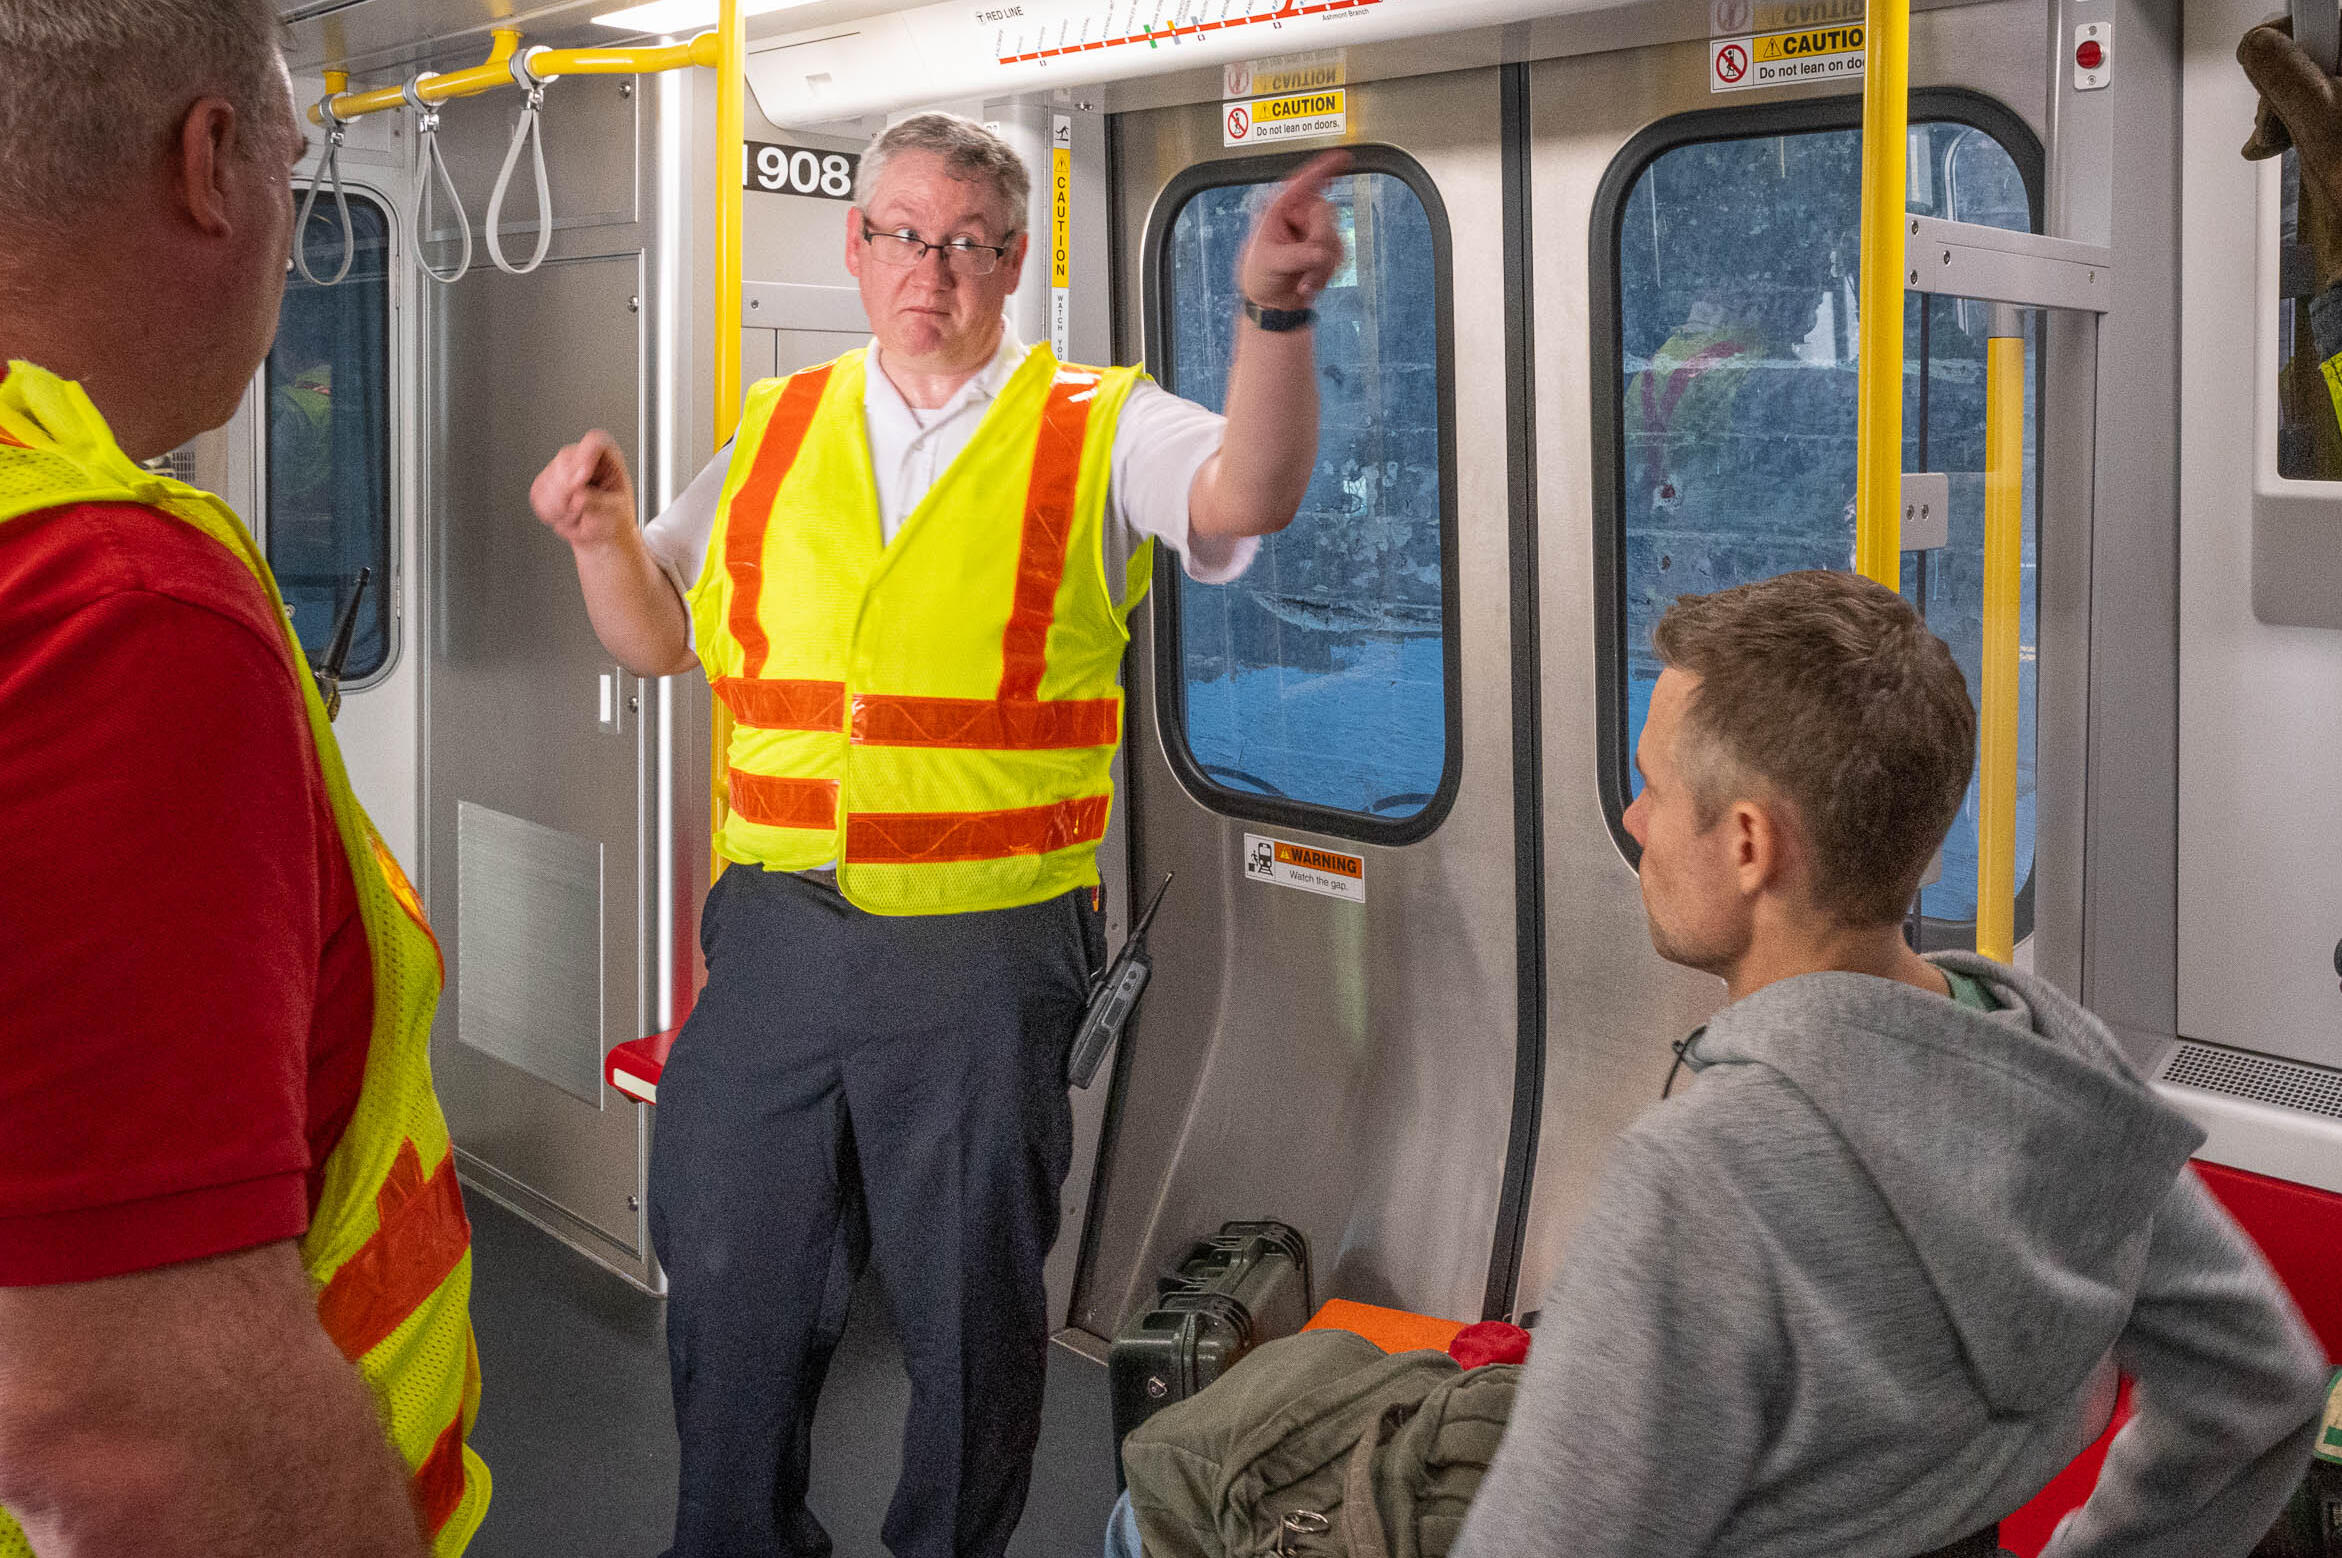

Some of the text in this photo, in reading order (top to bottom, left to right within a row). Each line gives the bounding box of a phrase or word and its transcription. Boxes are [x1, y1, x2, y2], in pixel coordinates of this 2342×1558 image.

[985, 10, 1003, 21] RED
[1004, 6, 1024, 18] LINE
[1322, 8, 1369, 21] Ashmont Branch
[1783, 28, 1864, 54] CAUTIO
[1759, 67, 1775, 79] Do
[1778, 65, 1797, 77] not
[1800, 62, 1825, 74] lean
[1828, 60, 1843, 71] on
[1272, 96, 1335, 116] CAUTION
[1256, 119, 1340, 136] Do not lean on doors.
[1056, 176, 1066, 276] CAUTION
[1291, 848, 1356, 873] WARNING
[1289, 870, 1314, 883] Watch
[1316, 875, 1328, 886] the
